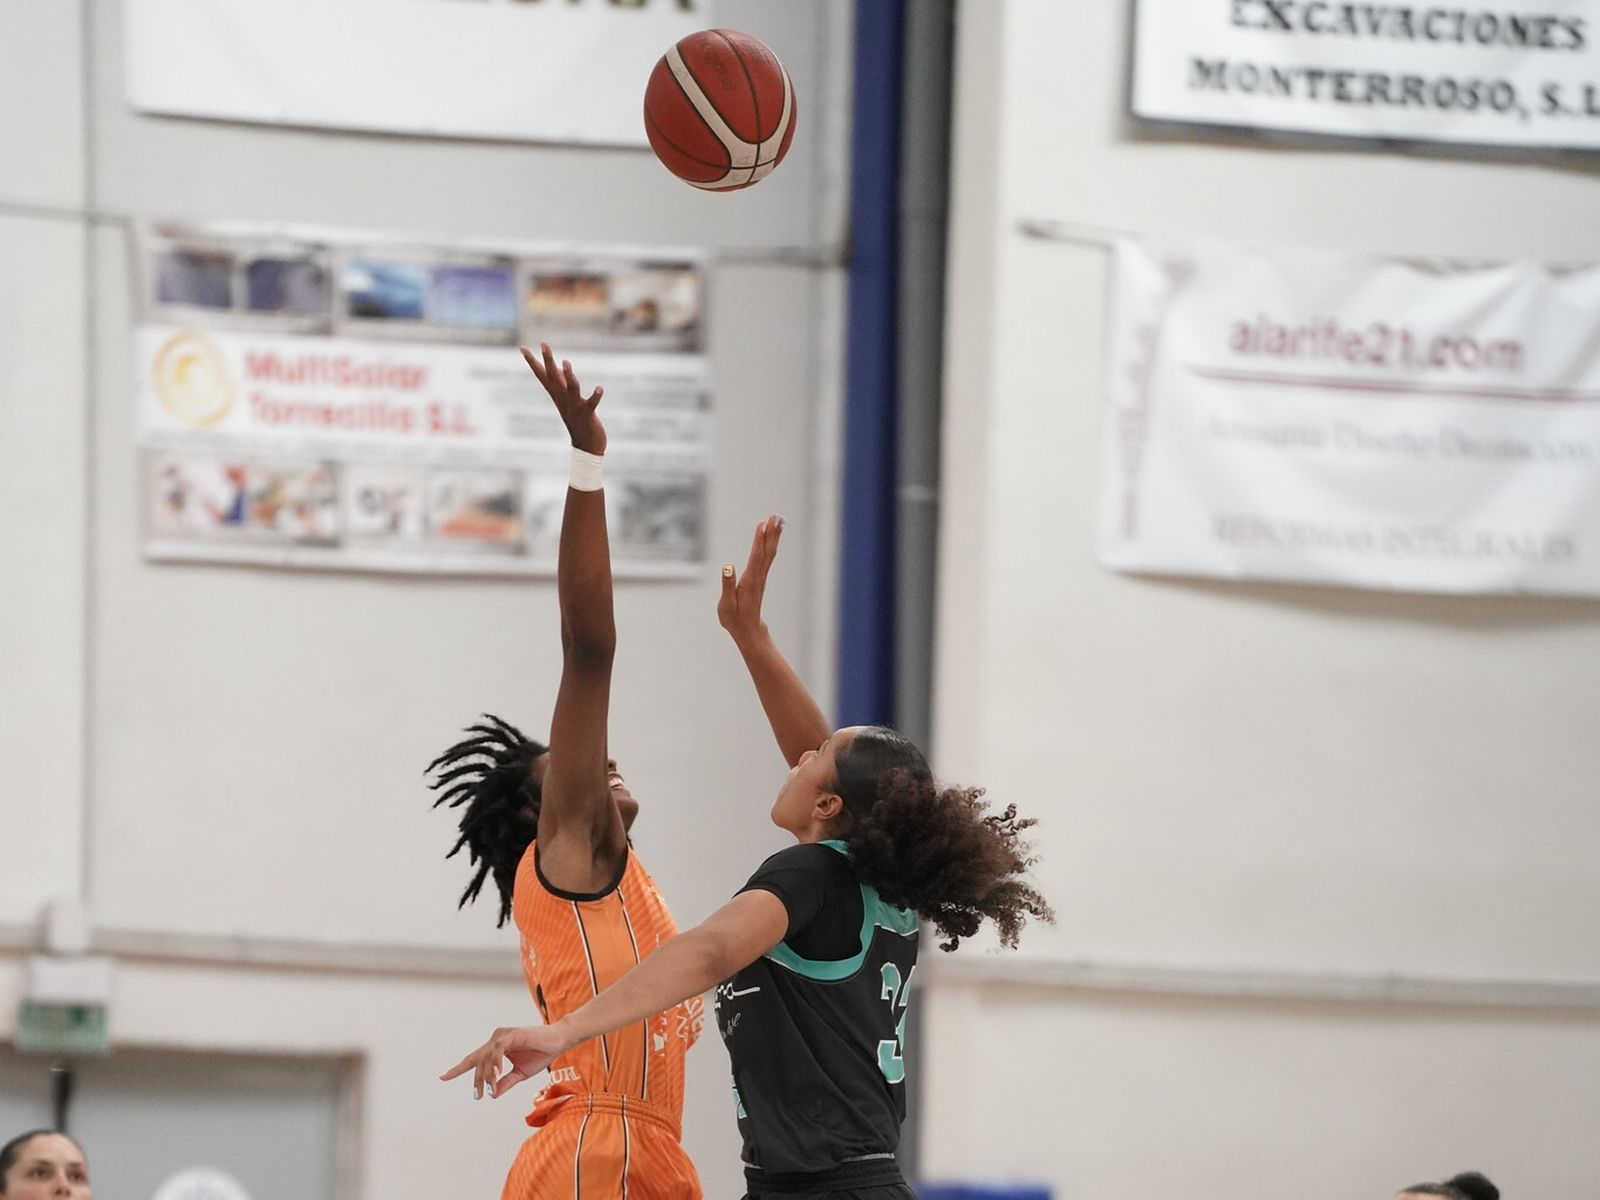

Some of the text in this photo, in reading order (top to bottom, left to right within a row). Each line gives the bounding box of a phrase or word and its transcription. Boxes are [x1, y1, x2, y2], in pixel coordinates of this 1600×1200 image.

[1230, 0, 1586, 51] EXCAVACIONES
[1189, 59, 1530, 123] MONTERROSO,
[1229, 316, 1524, 372] alarife21.com
